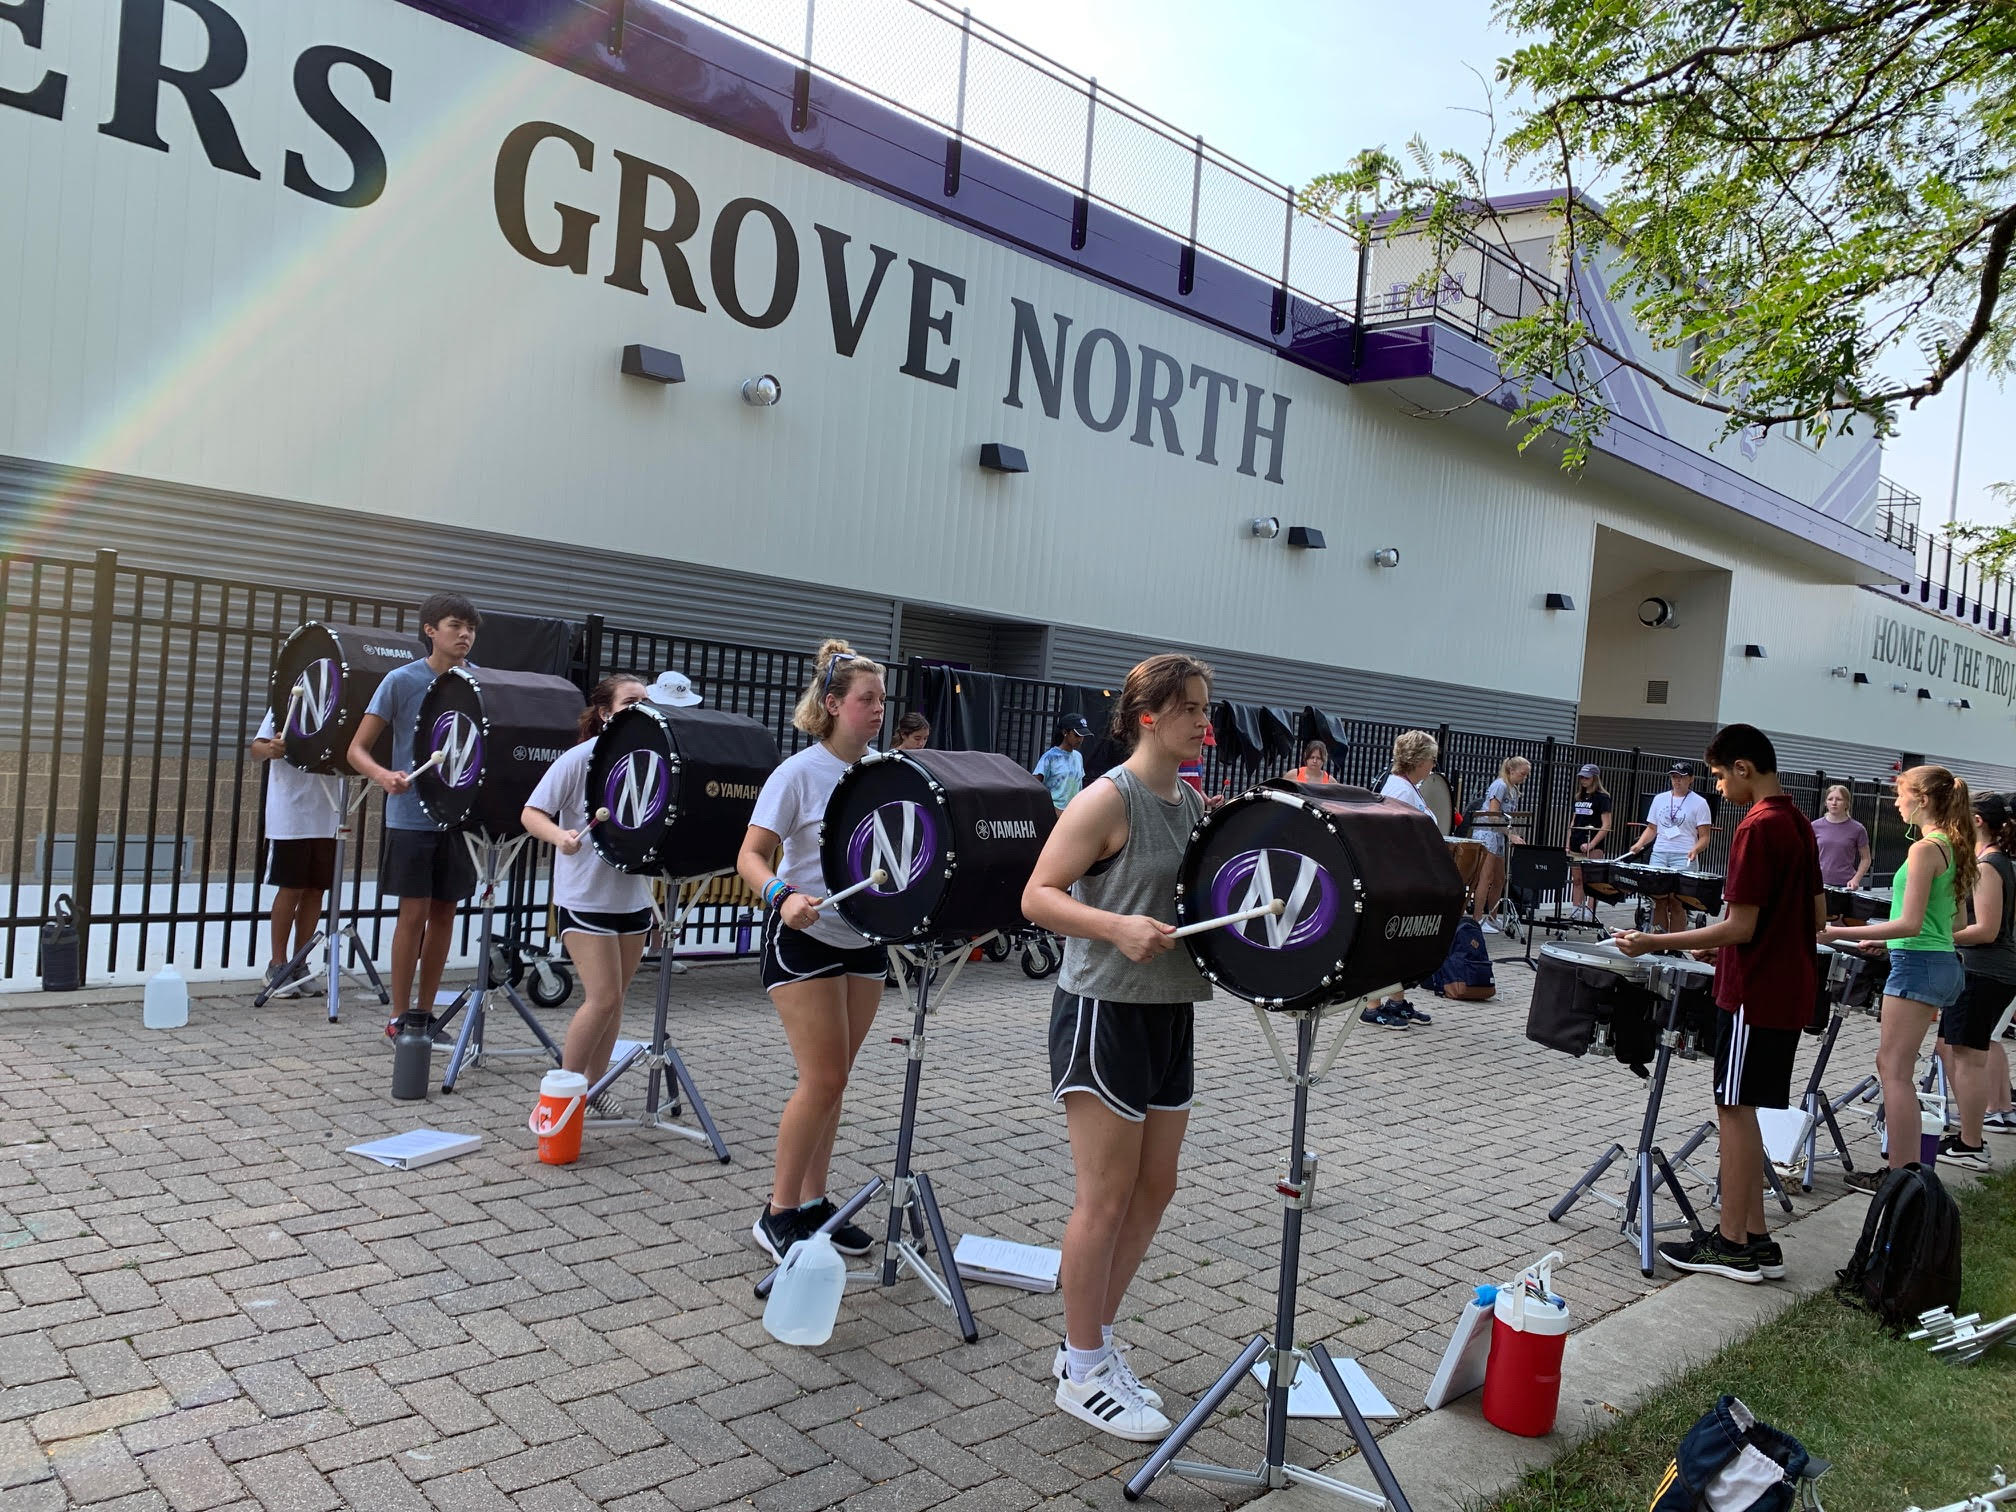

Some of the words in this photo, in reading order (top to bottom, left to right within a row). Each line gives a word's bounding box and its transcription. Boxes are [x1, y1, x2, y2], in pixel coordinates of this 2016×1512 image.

[494, 121, 966, 389] GROVE
[1002, 296, 1292, 485] NORTH
[374, 646, 414, 660] YAMAHA
[1872, 615, 1925, 673] HOME
[1928, 634, 1949, 679] OF
[1953, 643, 1982, 688] THE
[1986, 654, 2016, 707] TROJ
[528, 747, 566, 762] YAMA
[720, 782, 762, 800] YAMAH
[989, 820, 1037, 839] YAMAHA
[1398, 914, 1442, 938] YAMAHA
